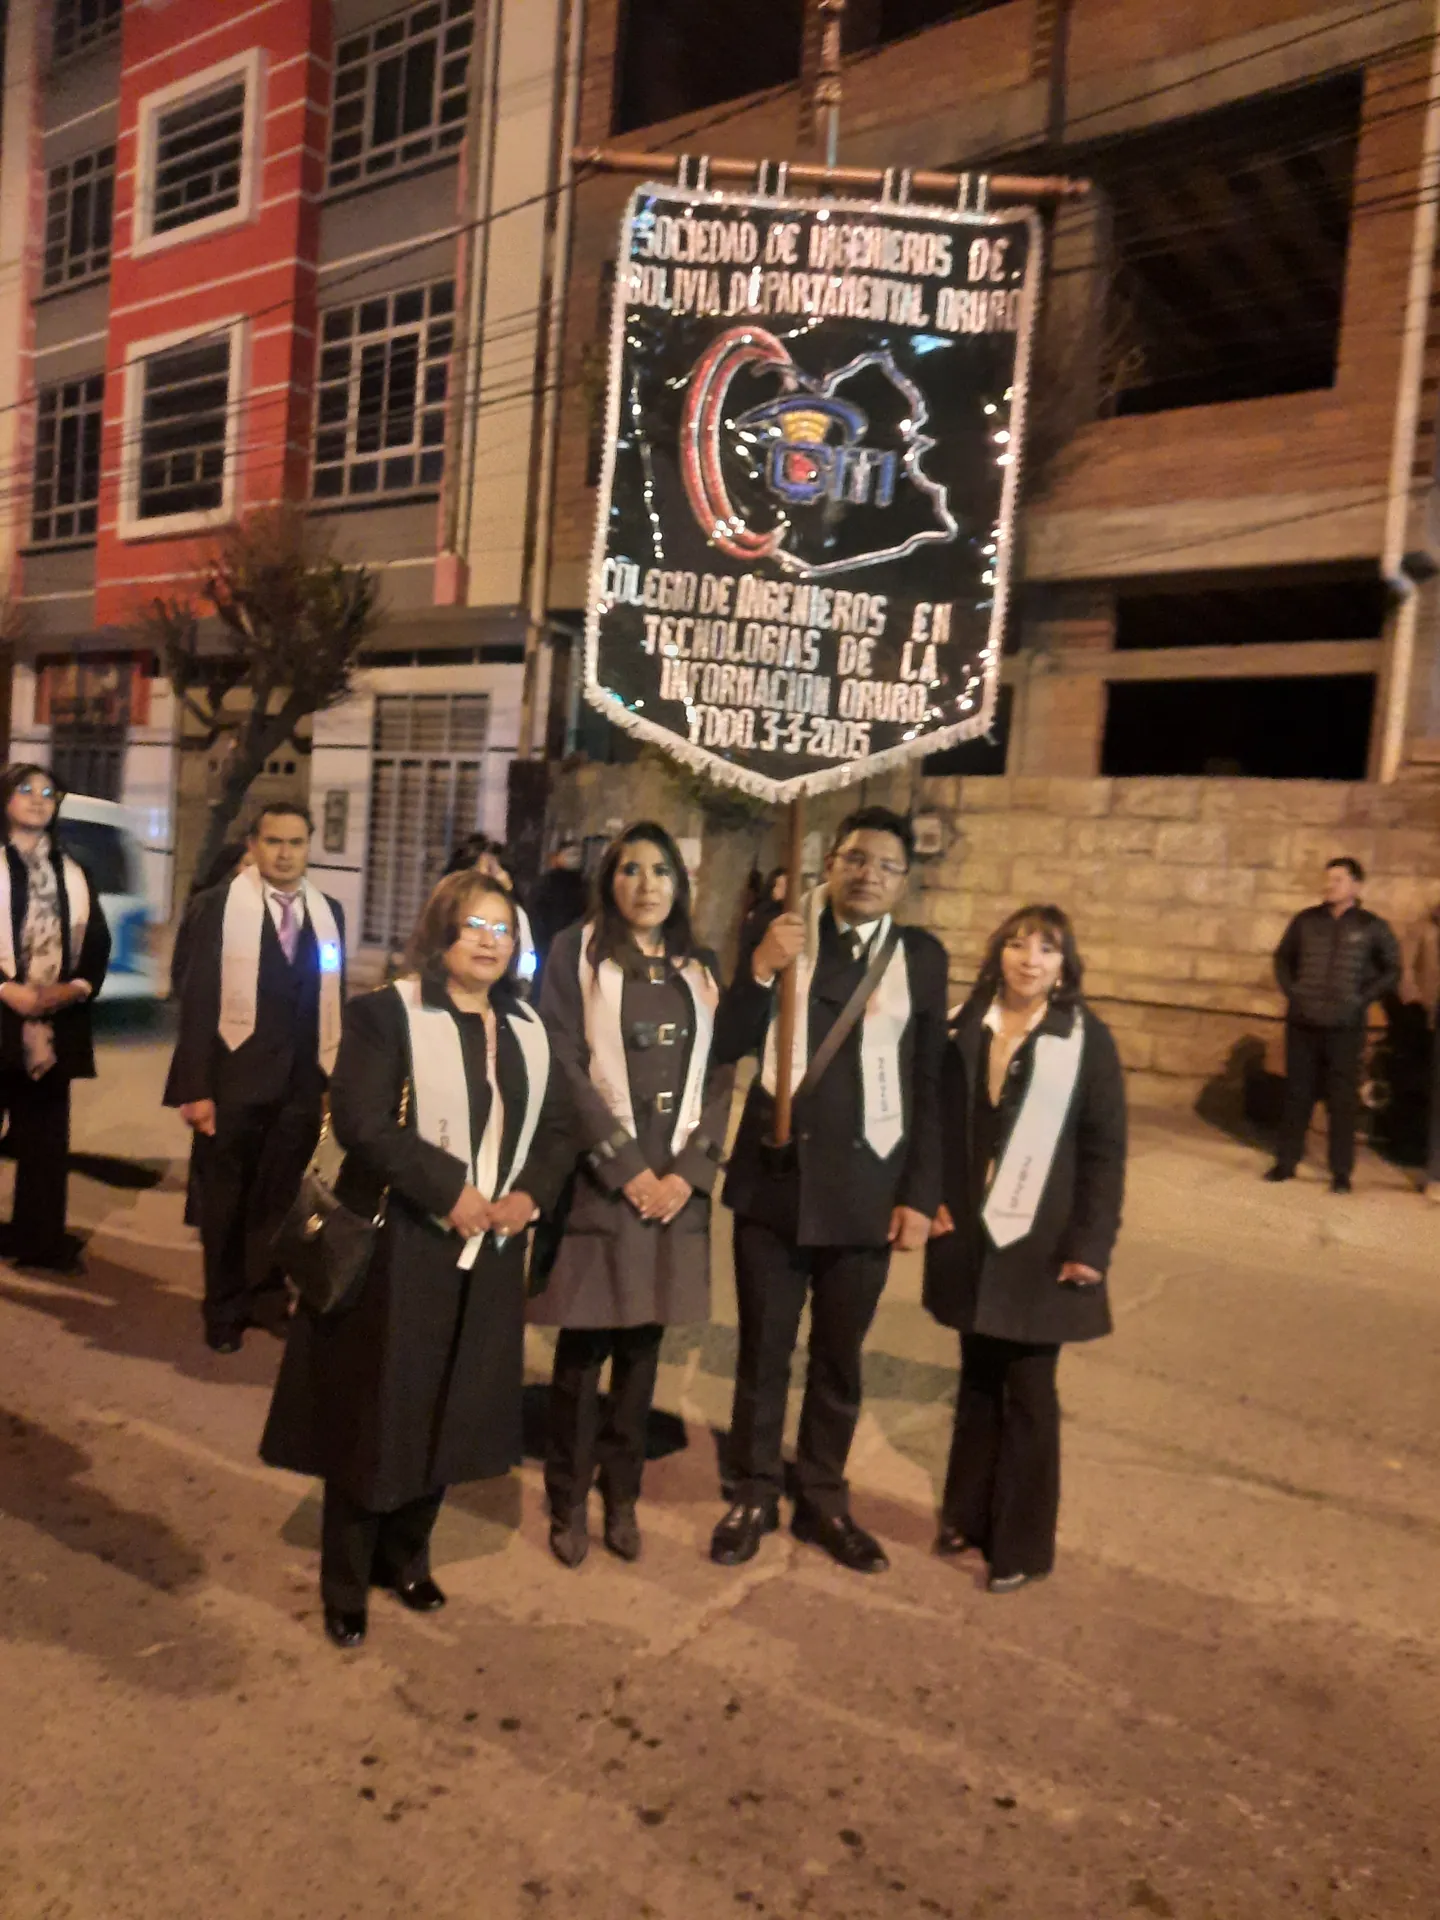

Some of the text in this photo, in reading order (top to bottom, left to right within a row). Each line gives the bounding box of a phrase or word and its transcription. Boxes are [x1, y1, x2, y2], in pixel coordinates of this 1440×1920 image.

[639, 214, 758, 264] SOCIEDAD
[766, 226, 798, 264] DE
[808, 225, 953, 278] INGENIEROS
[601, 560, 952, 643] COLEGIO DE INGENIEROS EN
[643, 614, 938, 684] TECNOLOGIAS DE LA
[661, 660, 927, 724] INFORMACION ORURO
